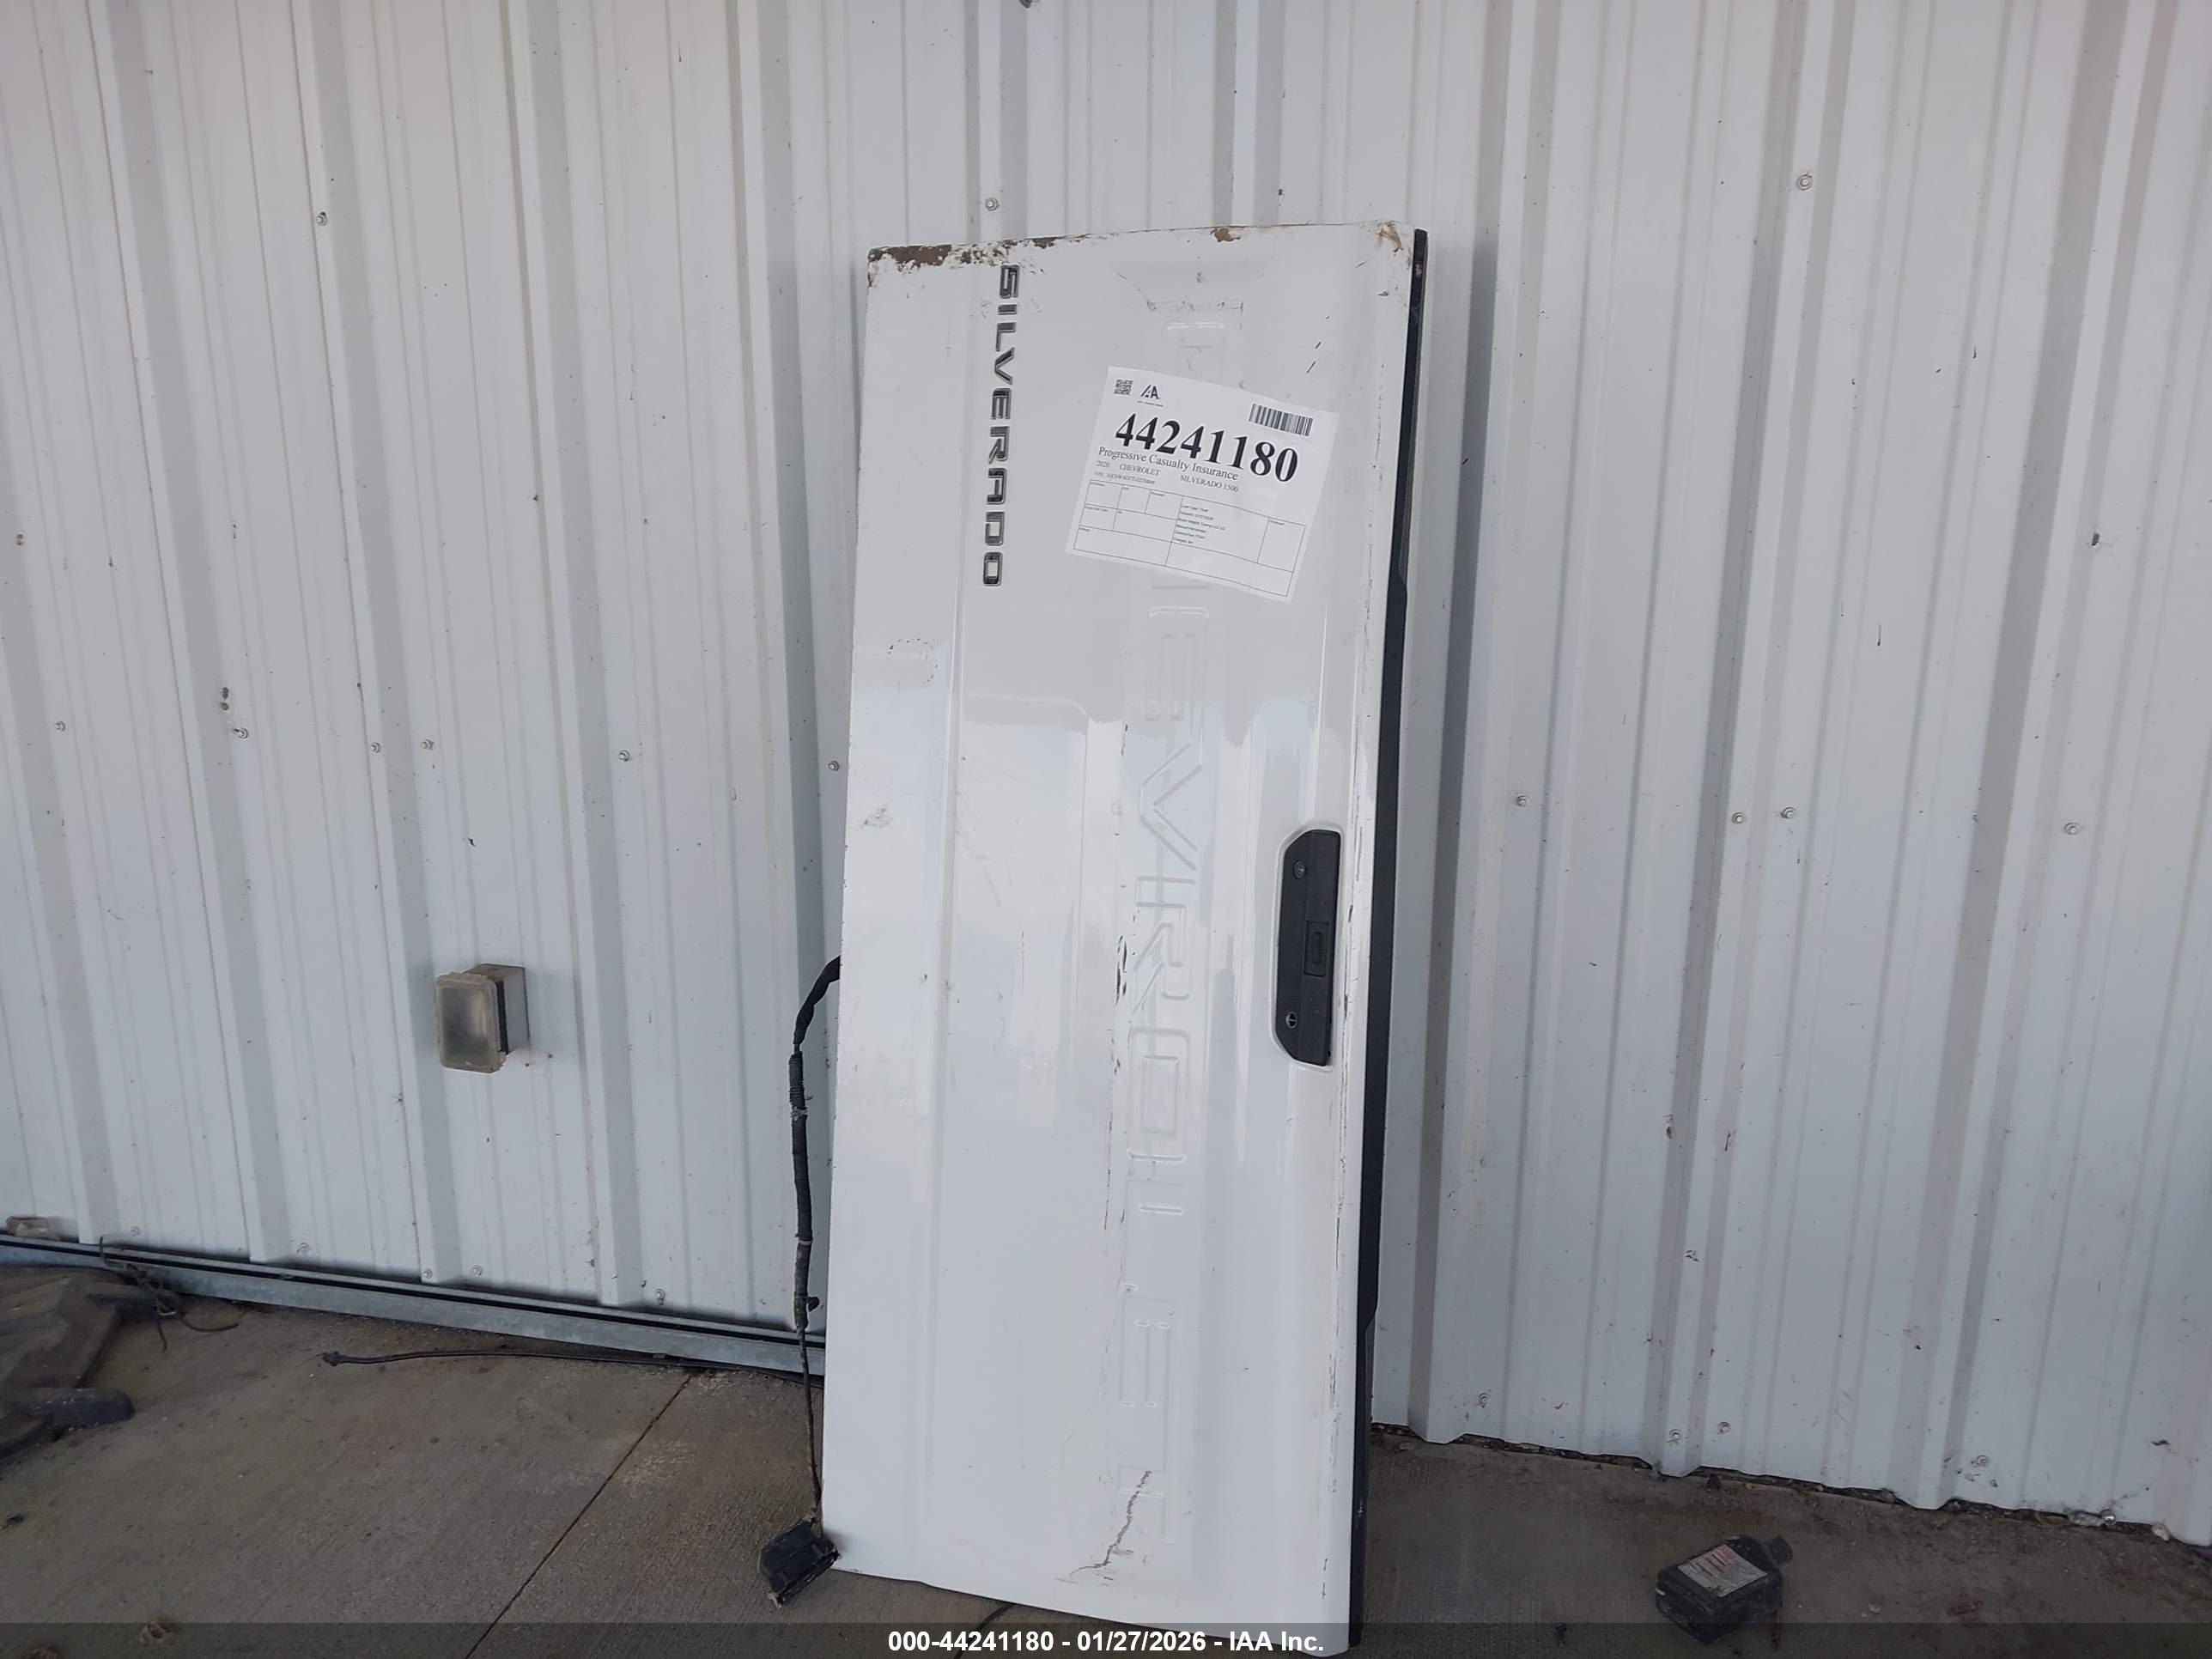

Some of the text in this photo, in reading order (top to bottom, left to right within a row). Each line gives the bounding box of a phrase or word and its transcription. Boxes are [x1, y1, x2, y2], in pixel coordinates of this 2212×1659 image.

[983, 264, 1019, 586] SILVERADO
[1115, 413, 1297, 482] 44241180
[1099, 447, 1239, 480] Progressive Casualty Insurance
[1119, 464, 1160, 477] CHEVROLET
[1180, 474, 1222, 489] SILVERADO
[1223, 483, 1238, 493] 1500
